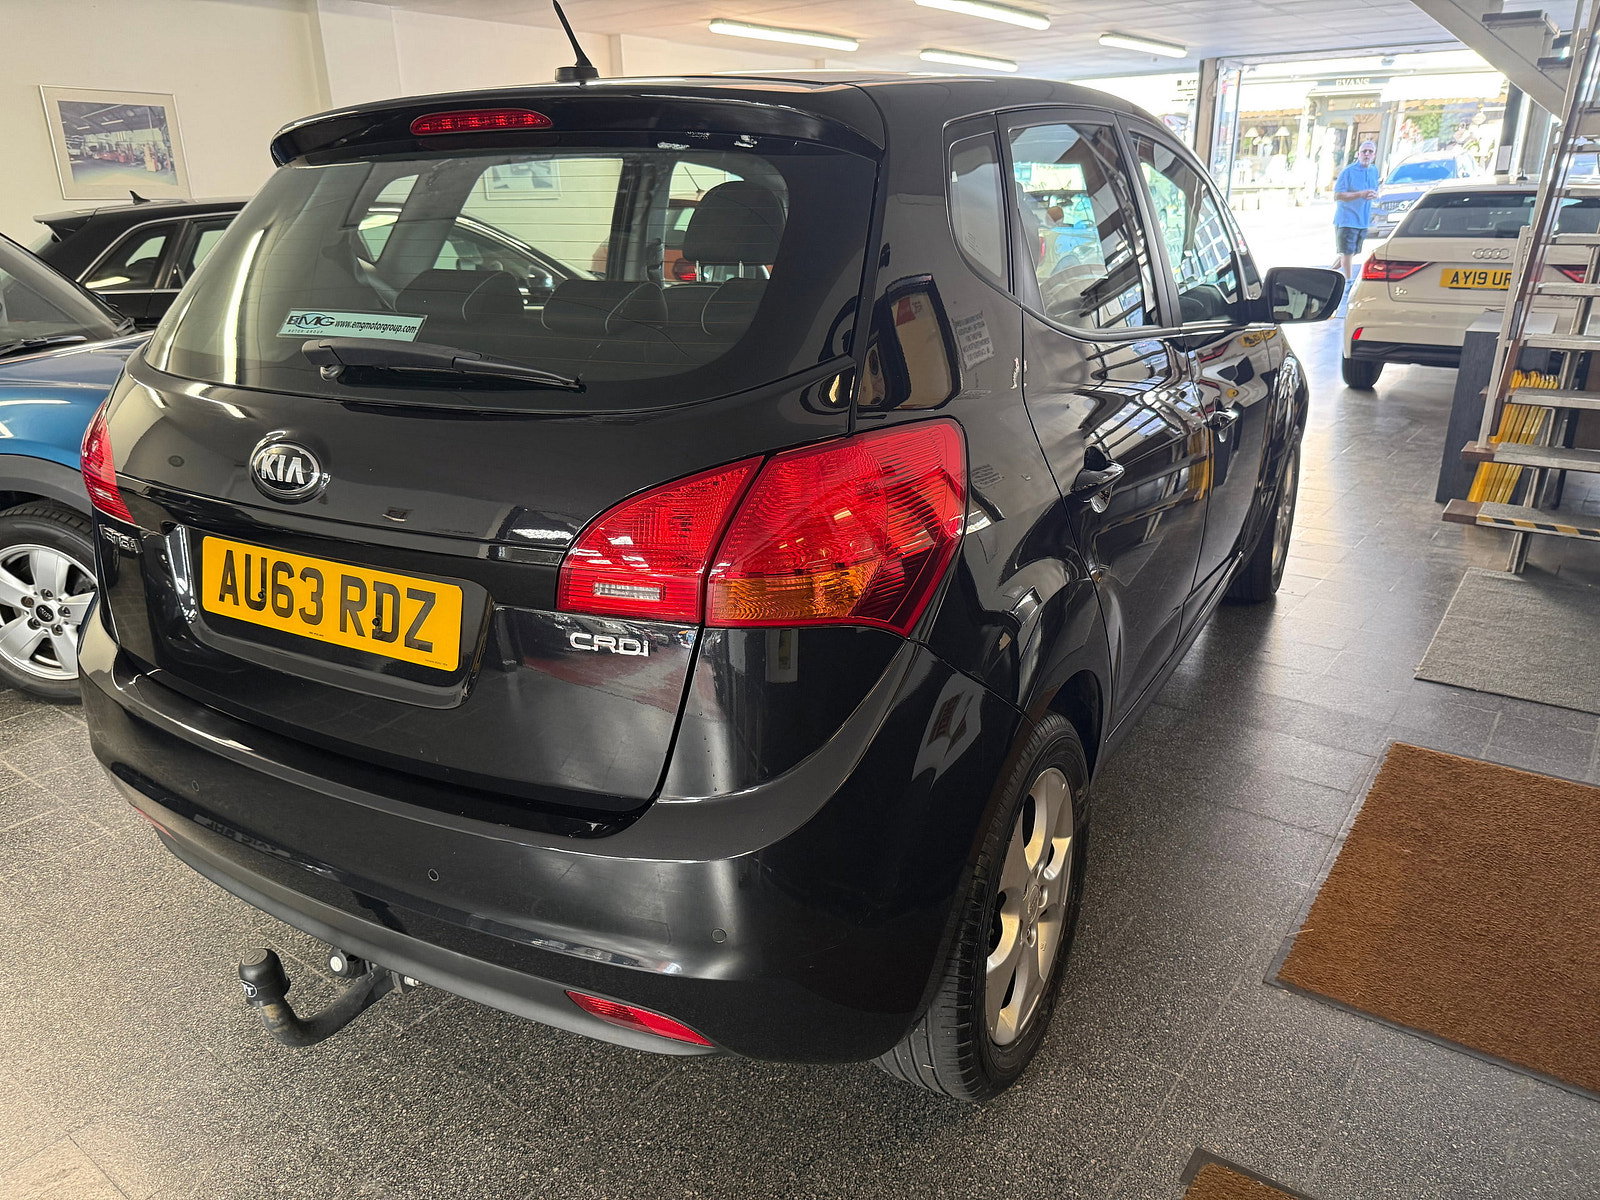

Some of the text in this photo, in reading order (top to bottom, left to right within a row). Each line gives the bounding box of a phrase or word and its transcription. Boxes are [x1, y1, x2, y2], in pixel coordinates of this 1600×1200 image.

[1335, 78, 1370, 87] EVANS
[1450, 271, 1488, 285] AY19
[287, 315, 417, 333] EMG www.emgmotorgroup.com
[260, 453, 306, 485] KIA
[218, 549, 437, 653] AU63 RDZ
